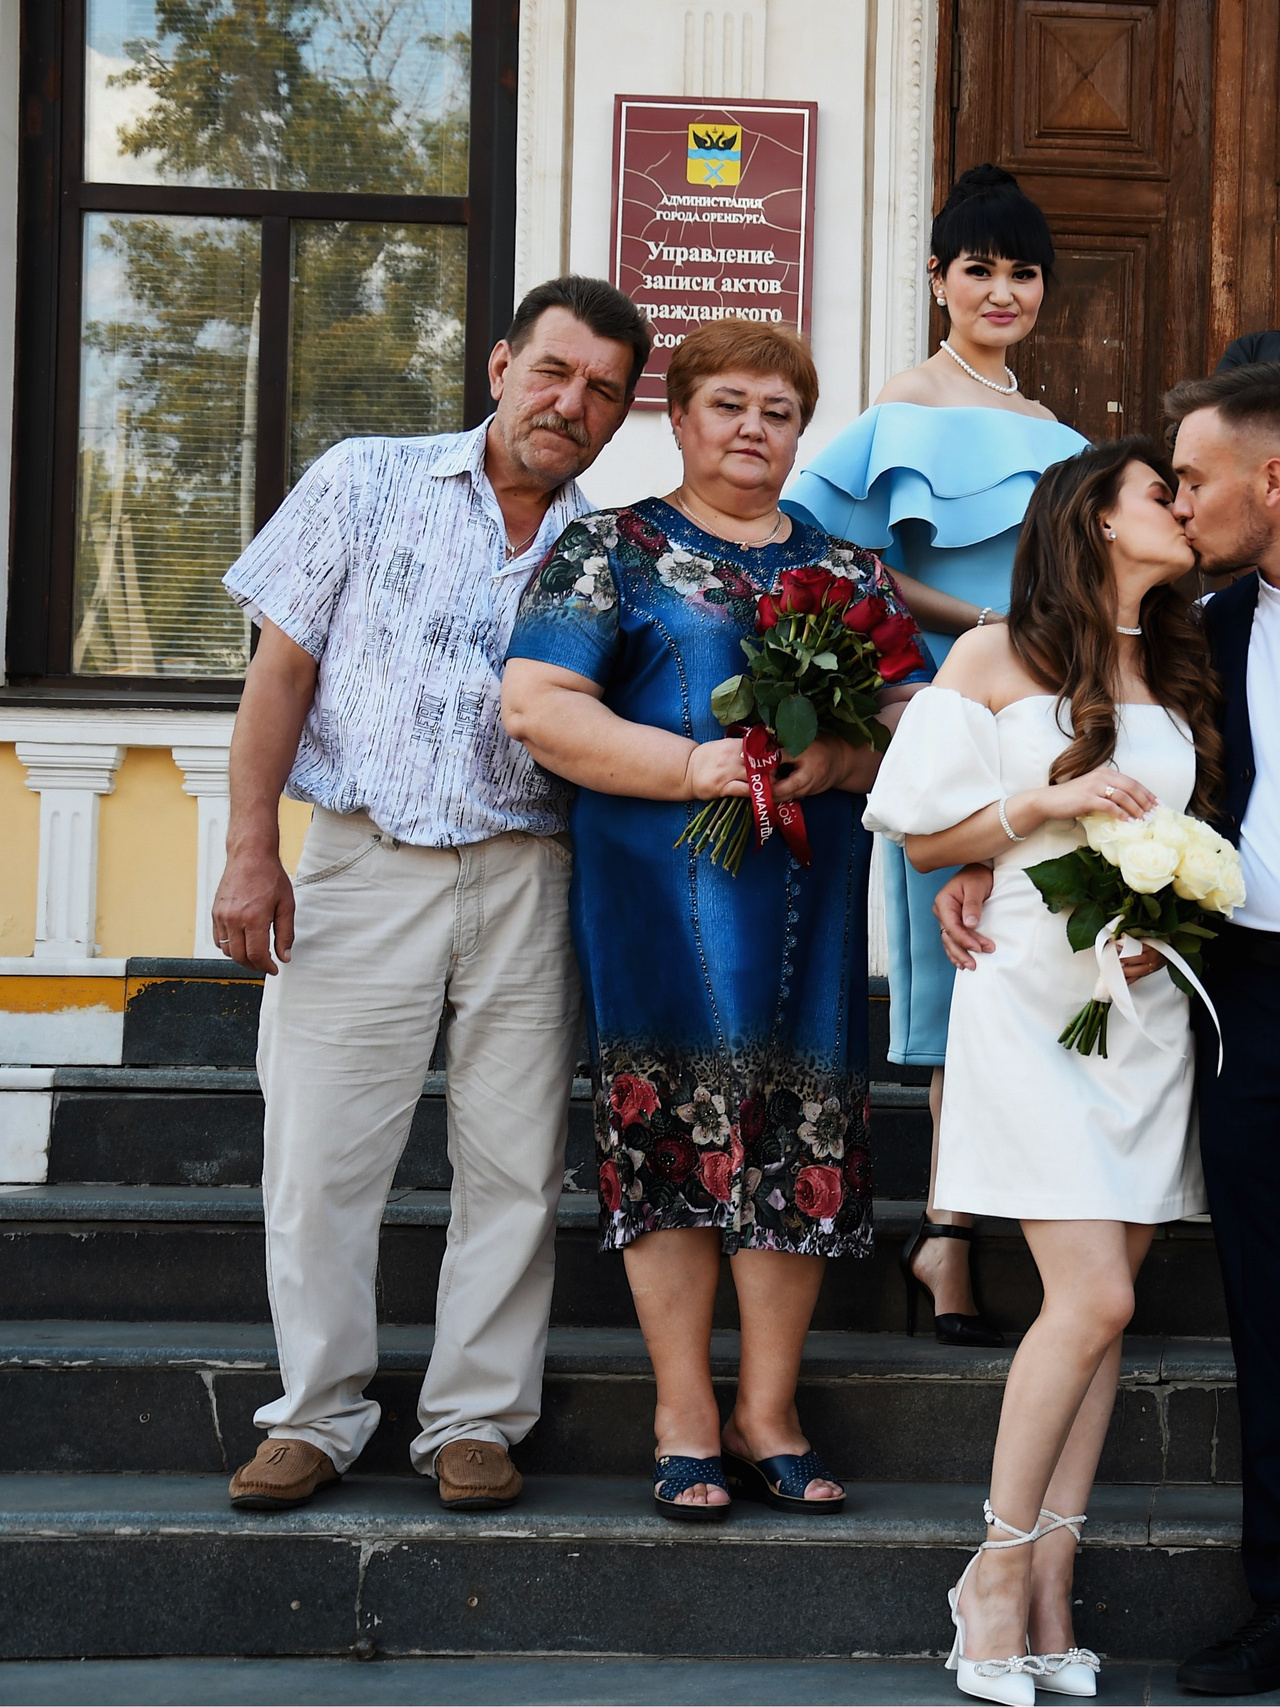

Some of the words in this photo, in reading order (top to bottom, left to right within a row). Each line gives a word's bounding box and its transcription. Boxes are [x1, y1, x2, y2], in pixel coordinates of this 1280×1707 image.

[660, 195, 763, 209] АДМИНИСТРАЦИЯ
[656, 210, 700, 222] ГОРОДА
[702, 212, 767, 225] ОРЕНБУРГА
[648, 240, 775, 267] Управление
[642, 275, 715, 292] записи
[721, 277, 782, 295] актов
